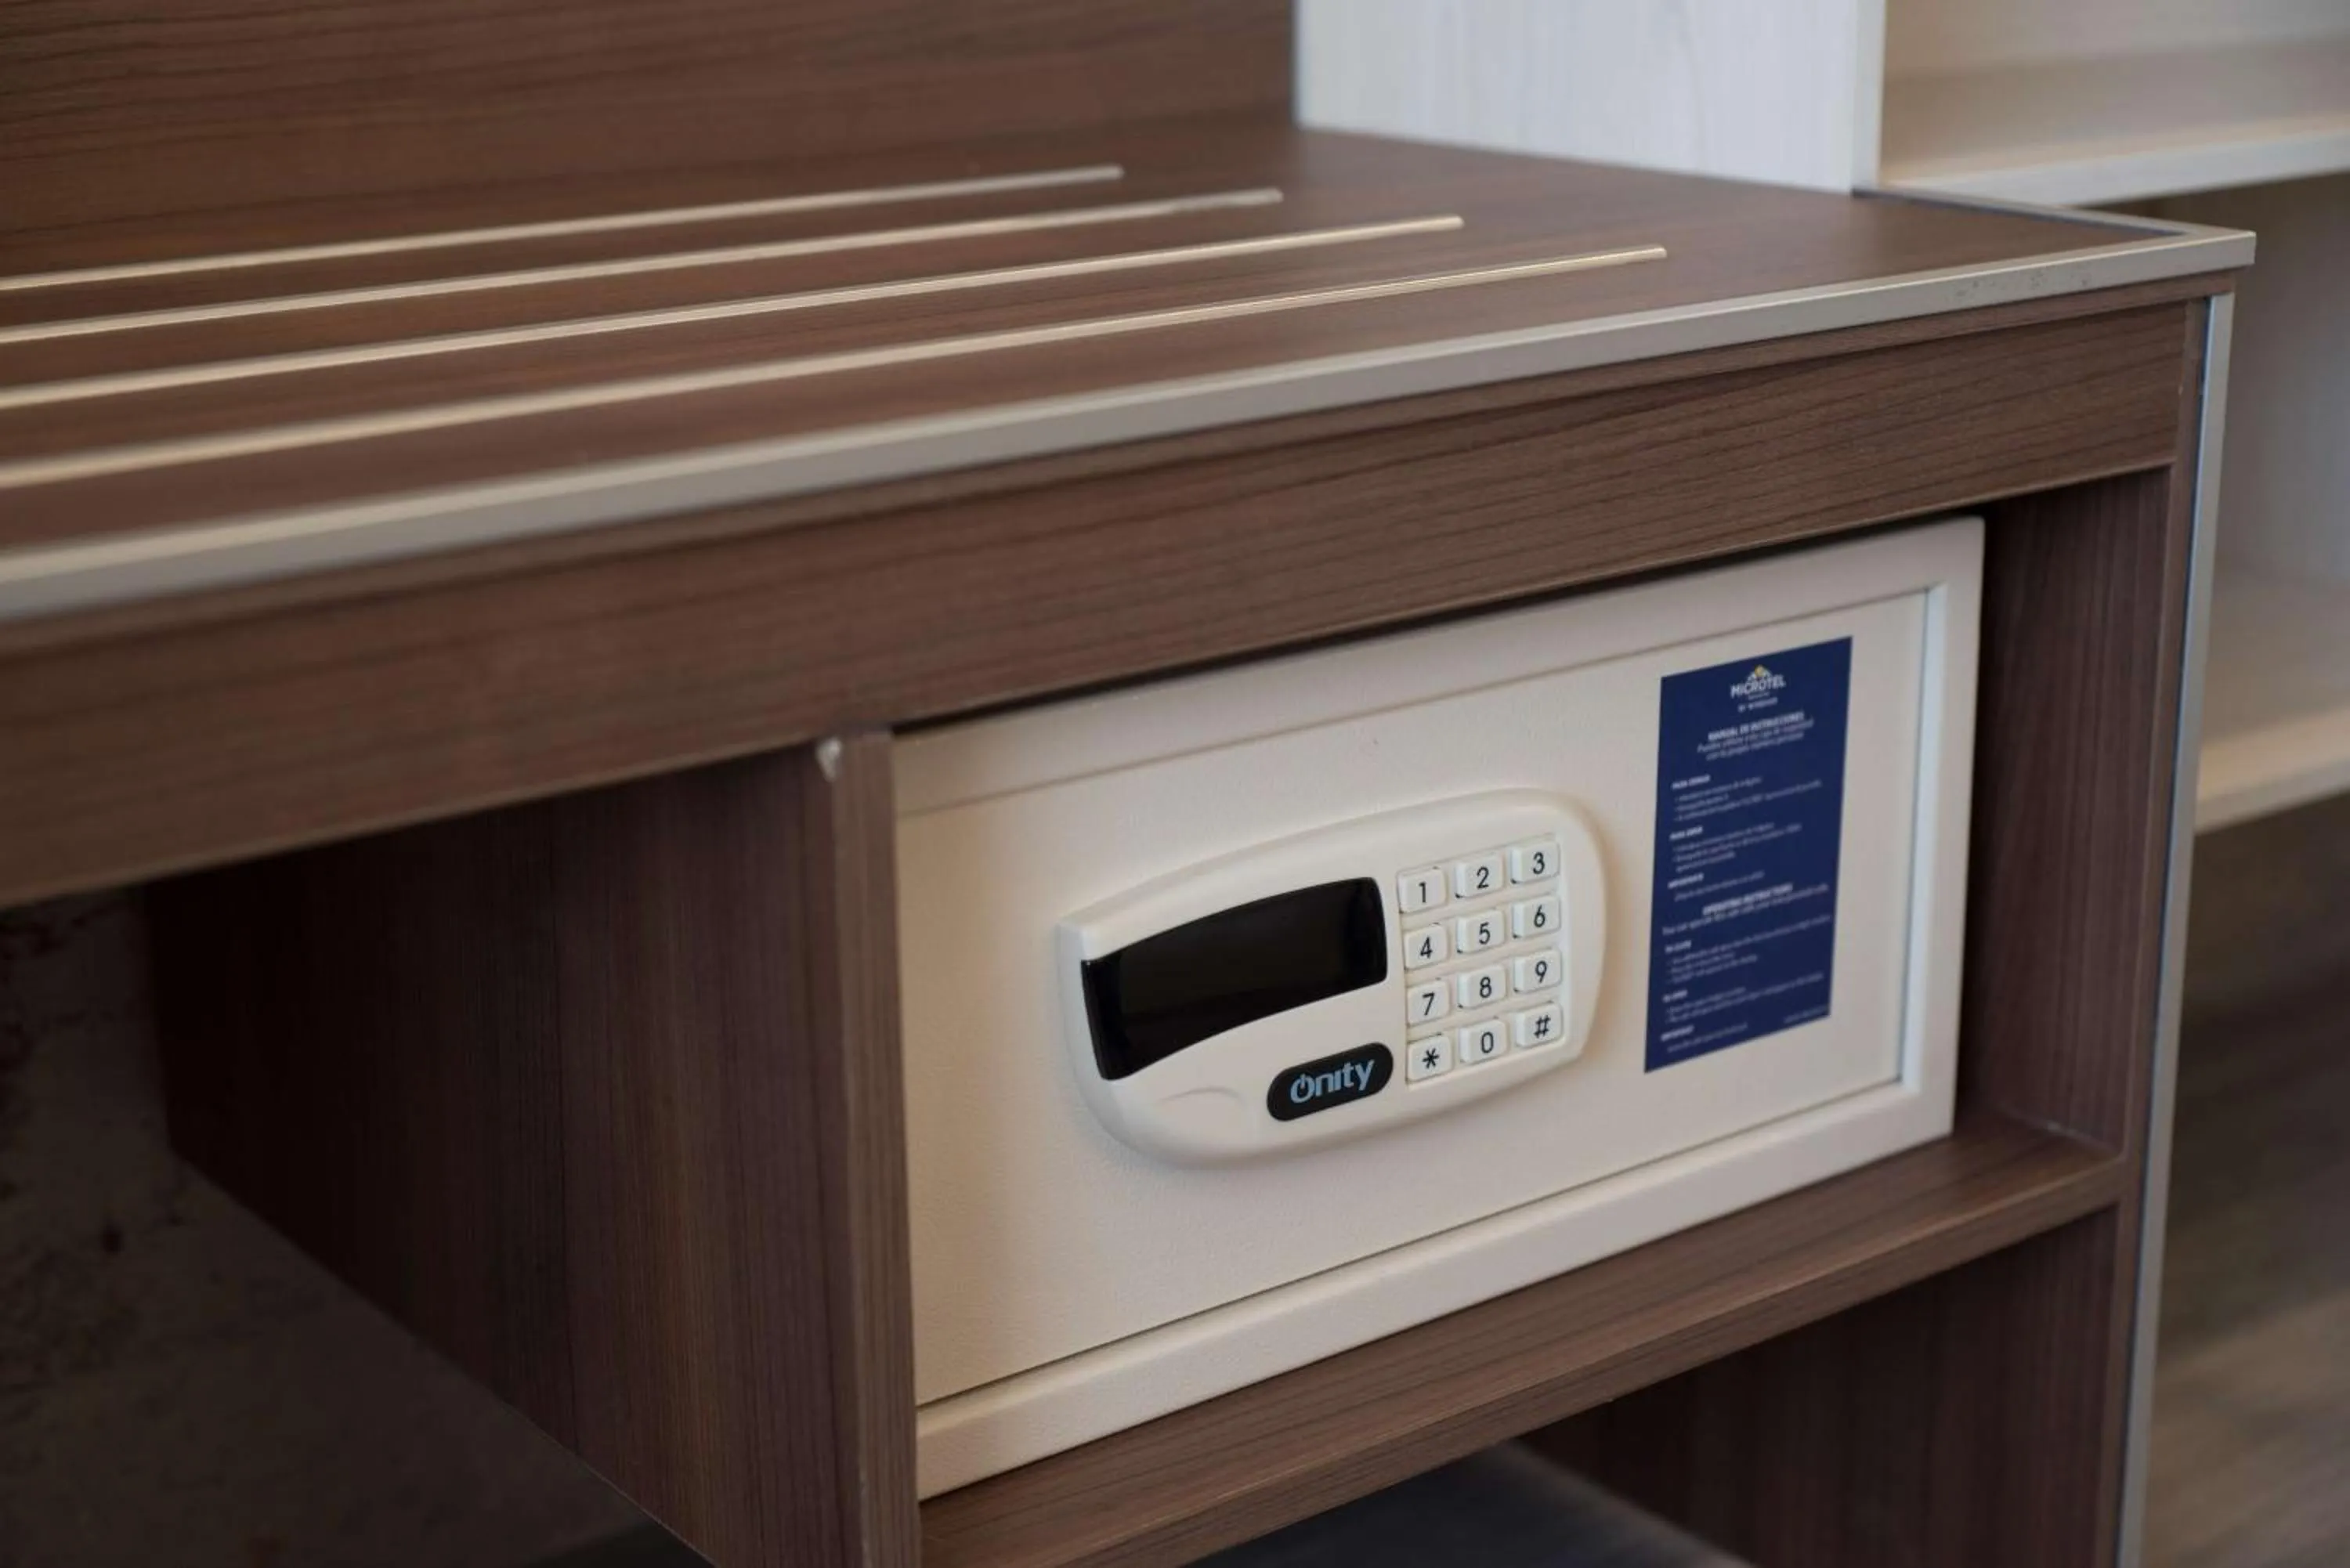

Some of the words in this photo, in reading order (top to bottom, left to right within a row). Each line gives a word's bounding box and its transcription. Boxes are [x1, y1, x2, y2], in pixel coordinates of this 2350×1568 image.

[1730, 674, 1787, 699] MICROTEL
[1418, 881, 1427, 903] 1
[1476, 866, 1490, 889] 2
[1532, 851, 1546, 875] 3
[1419, 936, 1434, 959] 4
[1478, 922, 1491, 945] 5
[1533, 905, 1546, 928] 6
[1422, 992, 1435, 1016] 7
[1479, 977, 1492, 999] 8
[1535, 960, 1548, 984] 9
[1480, 1031, 1495, 1054] 0
[1534, 1014, 1552, 1039] #
[1290, 1059, 1376, 1104] Onity
